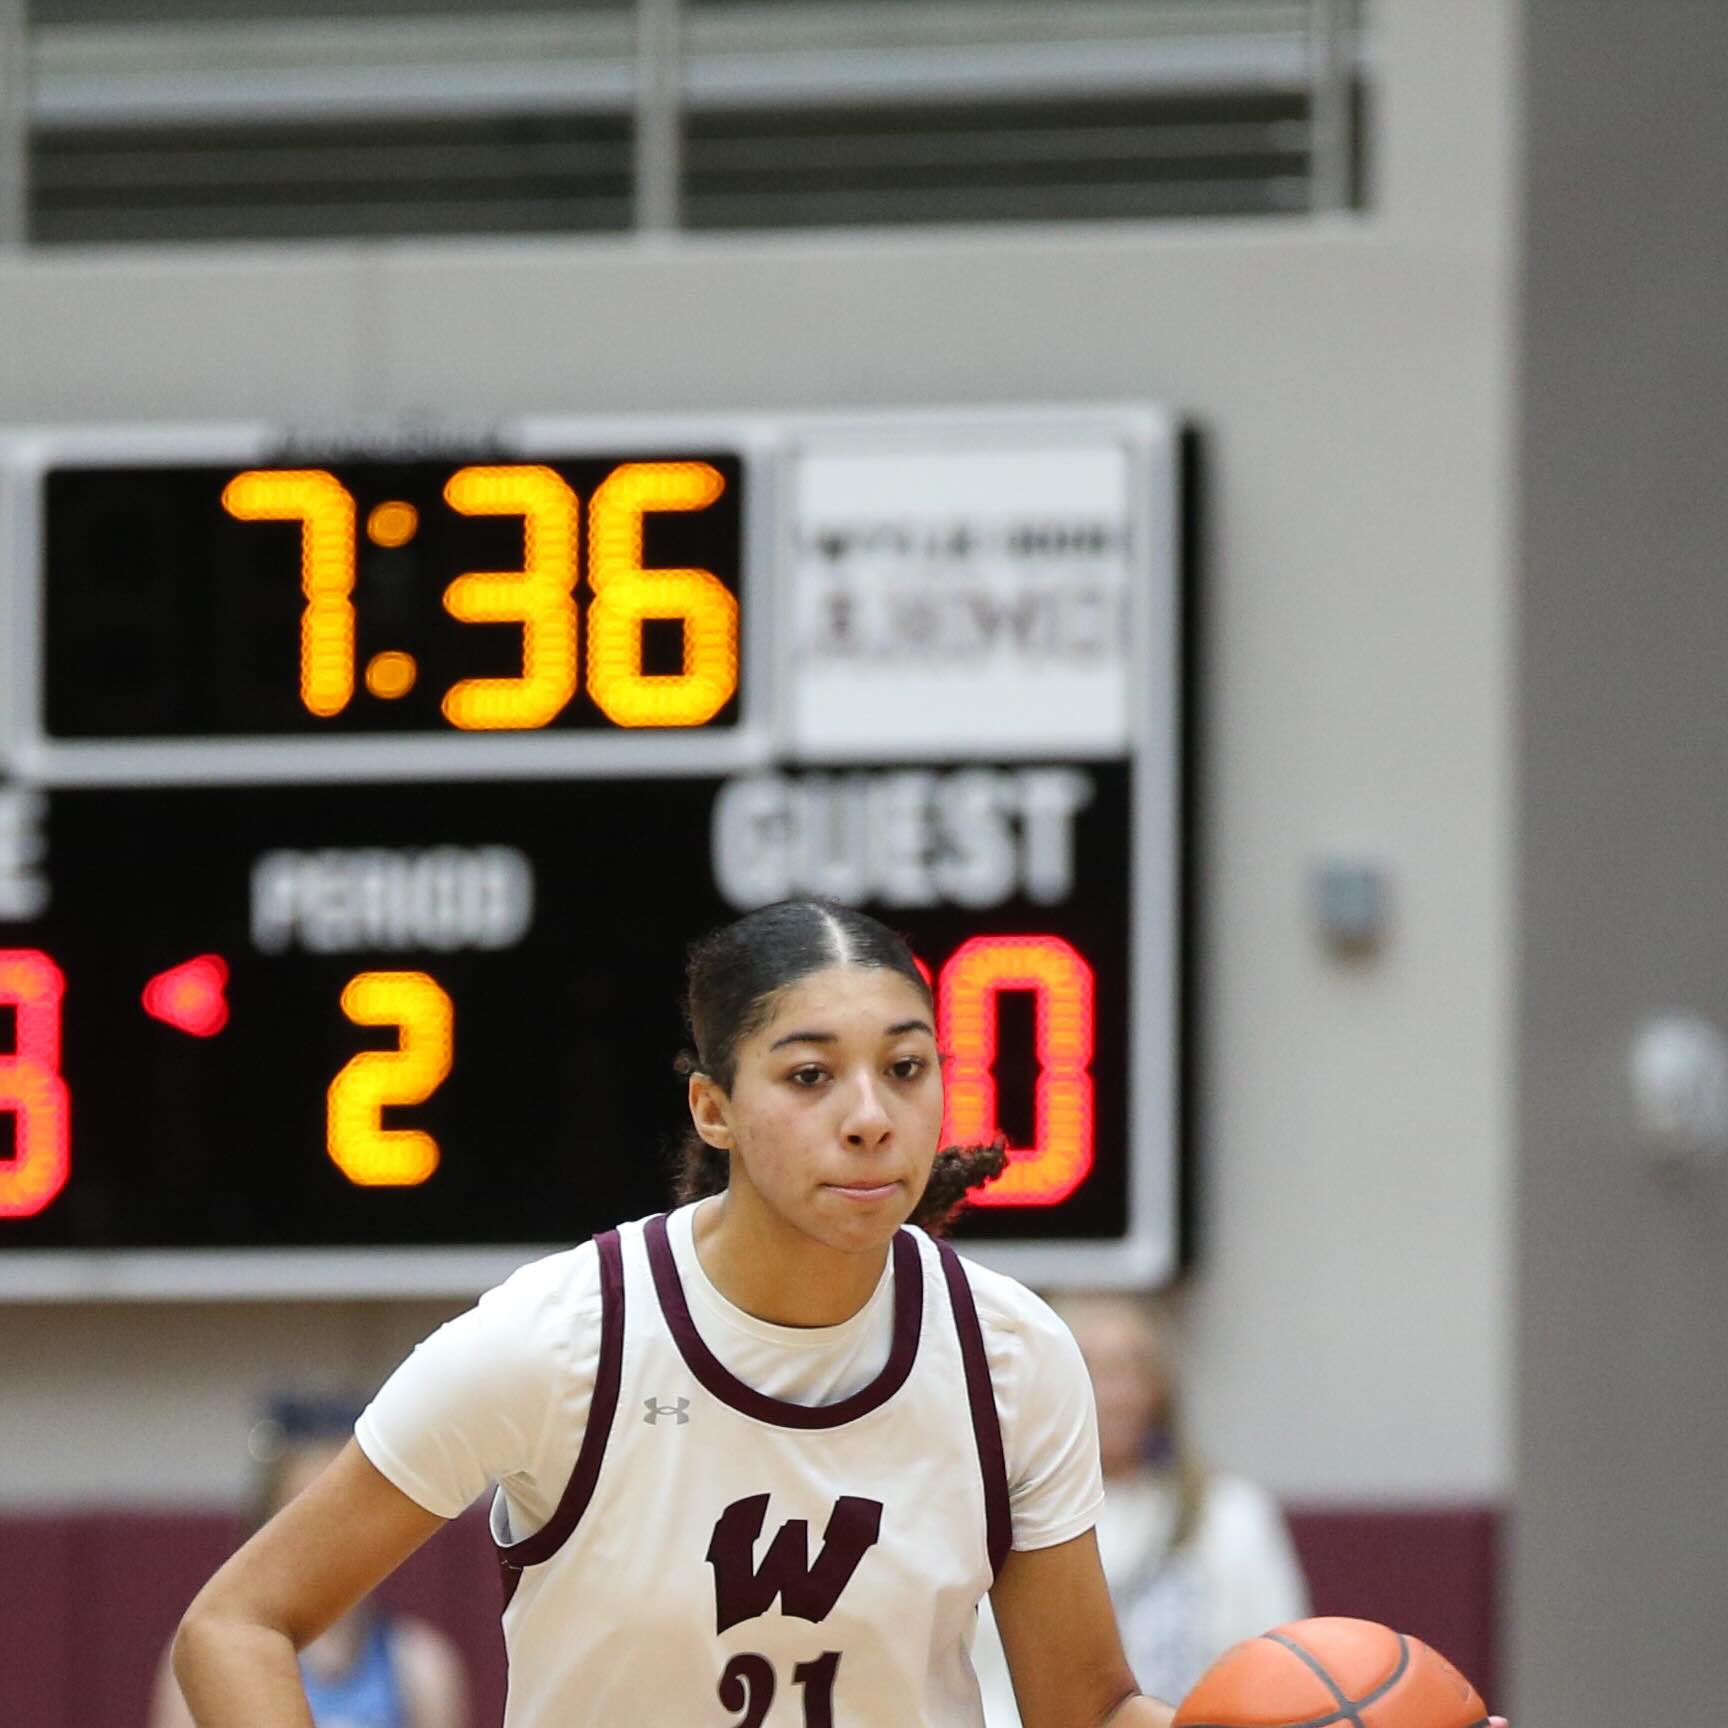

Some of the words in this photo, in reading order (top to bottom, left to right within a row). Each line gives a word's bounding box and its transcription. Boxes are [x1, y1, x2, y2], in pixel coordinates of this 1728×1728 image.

[221, 461, 740, 731] 7:36
[251, 845, 535, 955] PERIOD
[710, 768, 1096, 910] GUEST
[326, 971, 454, 1186] 2
[912, 934, 1095, 1207] 0
[705, 1493, 884, 1637] W
